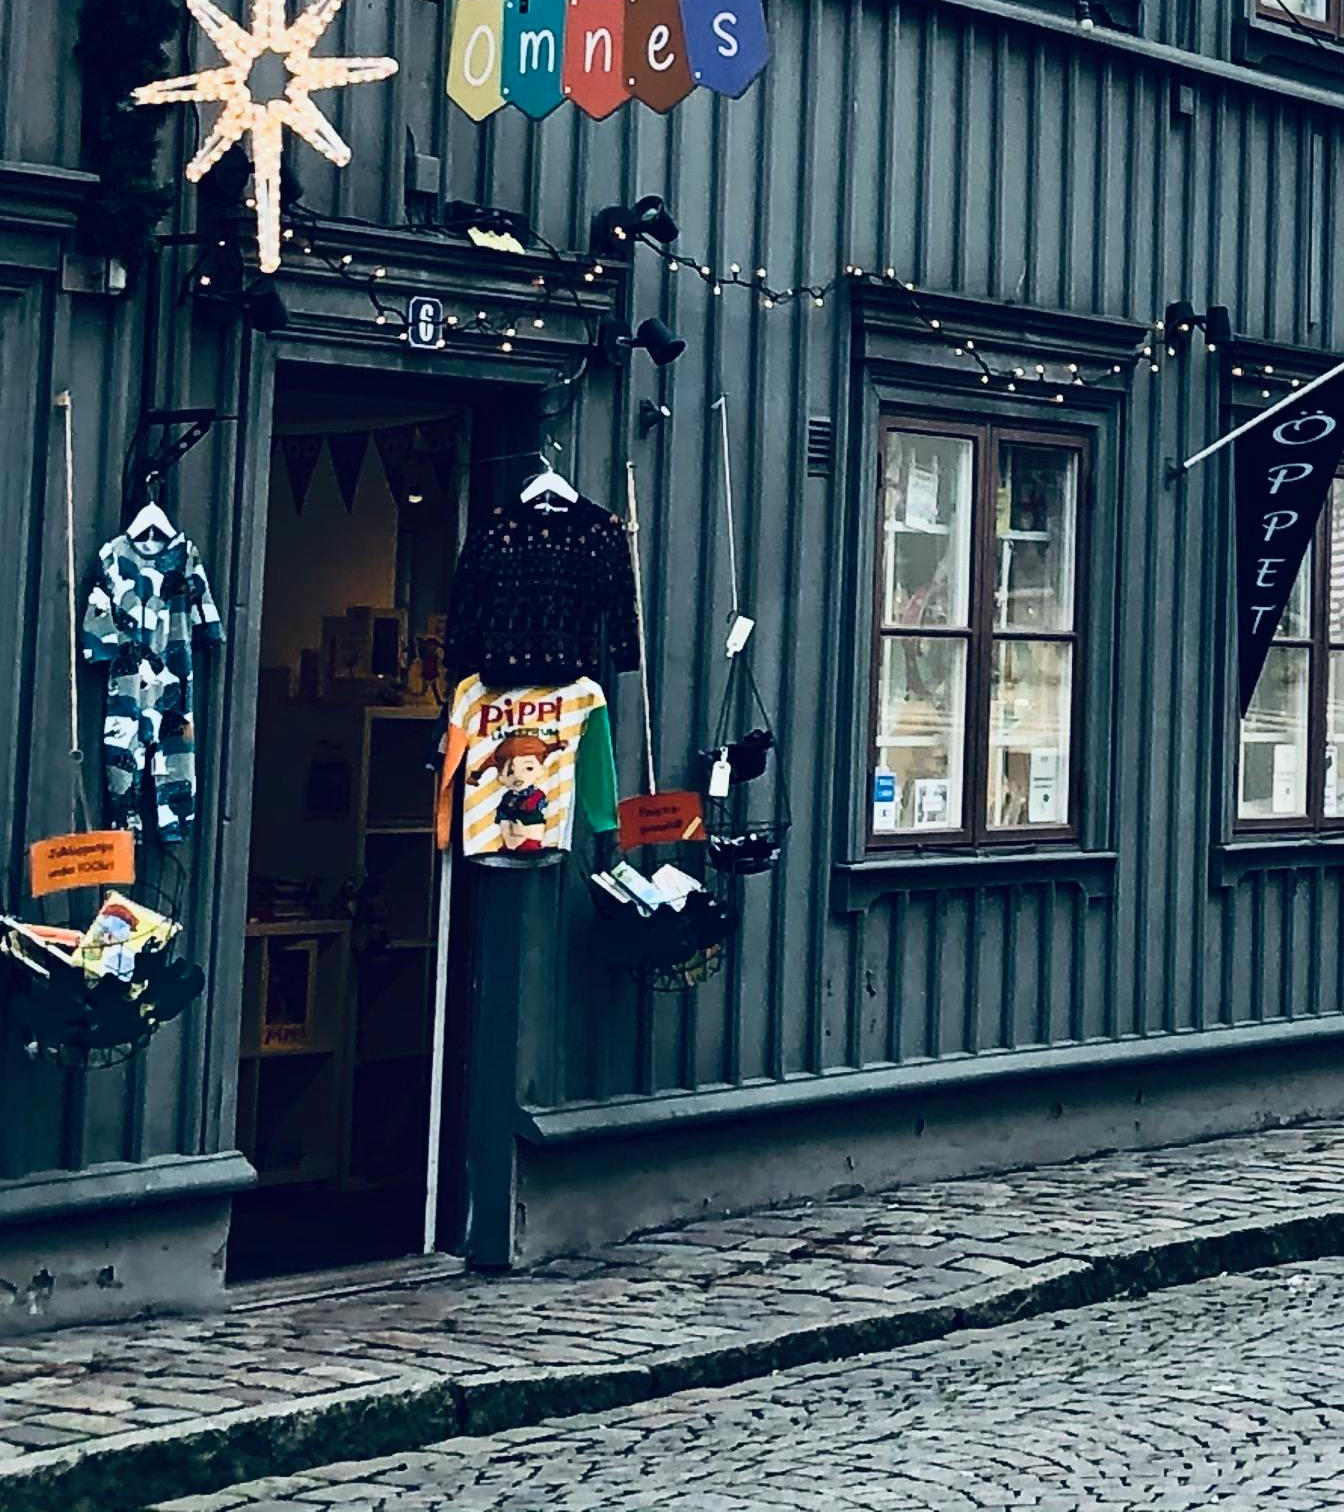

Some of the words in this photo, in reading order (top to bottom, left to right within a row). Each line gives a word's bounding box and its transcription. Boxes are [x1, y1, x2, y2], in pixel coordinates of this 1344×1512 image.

[464, 12, 739, 86] omnes
[419, 303, 434, 342] 6
[1251, 410, 1336, 635] ÖPPET
